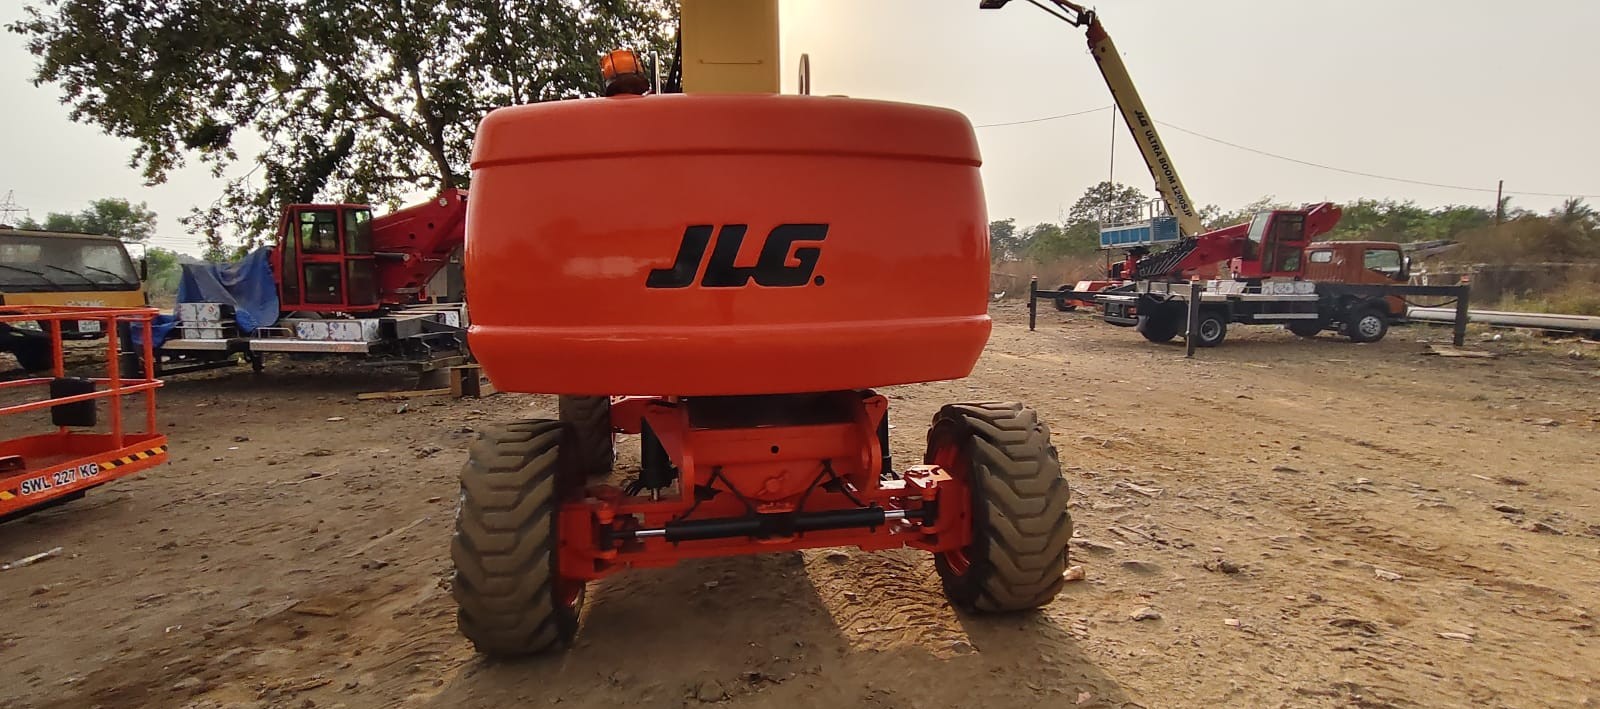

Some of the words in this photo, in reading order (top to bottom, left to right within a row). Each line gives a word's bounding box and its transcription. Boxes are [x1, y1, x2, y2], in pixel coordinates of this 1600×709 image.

[1135, 110, 1148, 127] JLG
[1145, 130, 1162, 157] ULTRA
[1159, 157, 1176, 185] BOOM
[1172, 185, 1192, 217] 1200SJP
[22, 477, 51, 494] SWL
[54, 469, 76, 485] 227
[79, 463, 99, 477] KG
